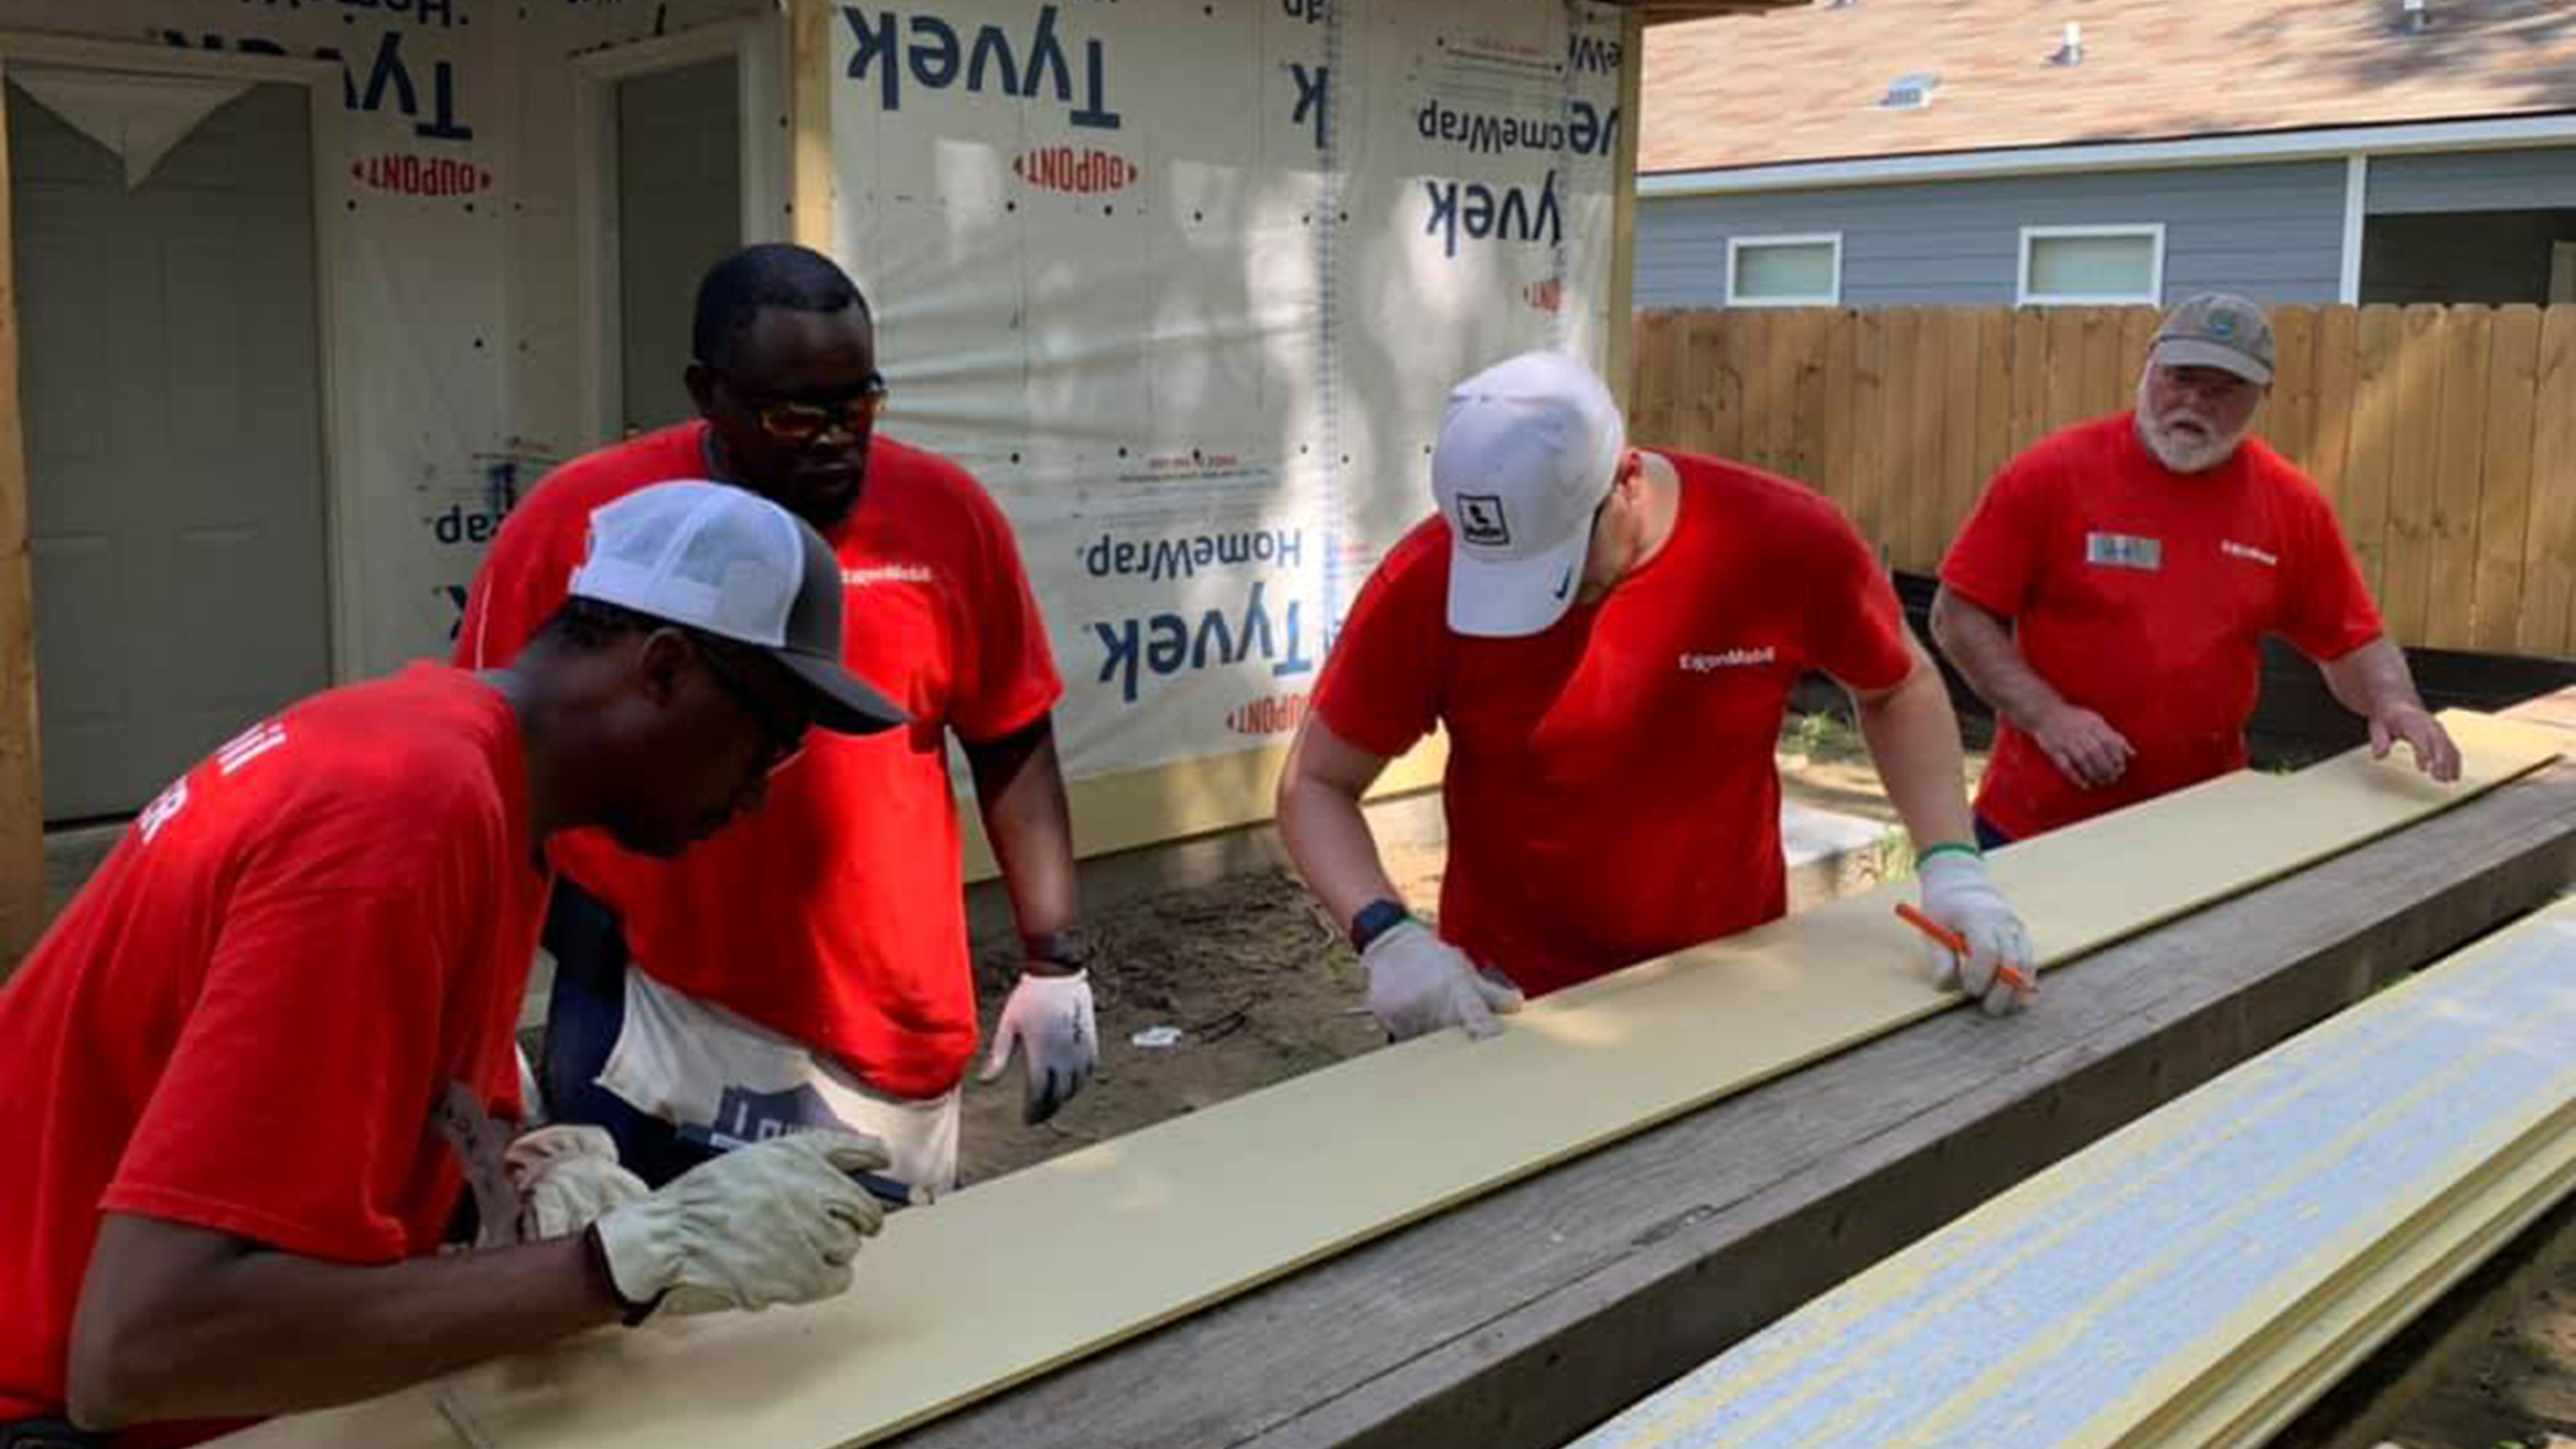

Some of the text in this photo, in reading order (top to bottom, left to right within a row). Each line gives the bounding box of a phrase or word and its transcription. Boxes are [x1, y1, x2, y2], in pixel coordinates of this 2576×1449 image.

[843, 5, 1121, 129] Tyvek
[369, 154, 475, 197] DUPONT
[1027, 148, 1124, 193] DUPONT
[1086, 530, 1301, 580] HomeWrap
[1094, 581, 1312, 702] Tyvek
